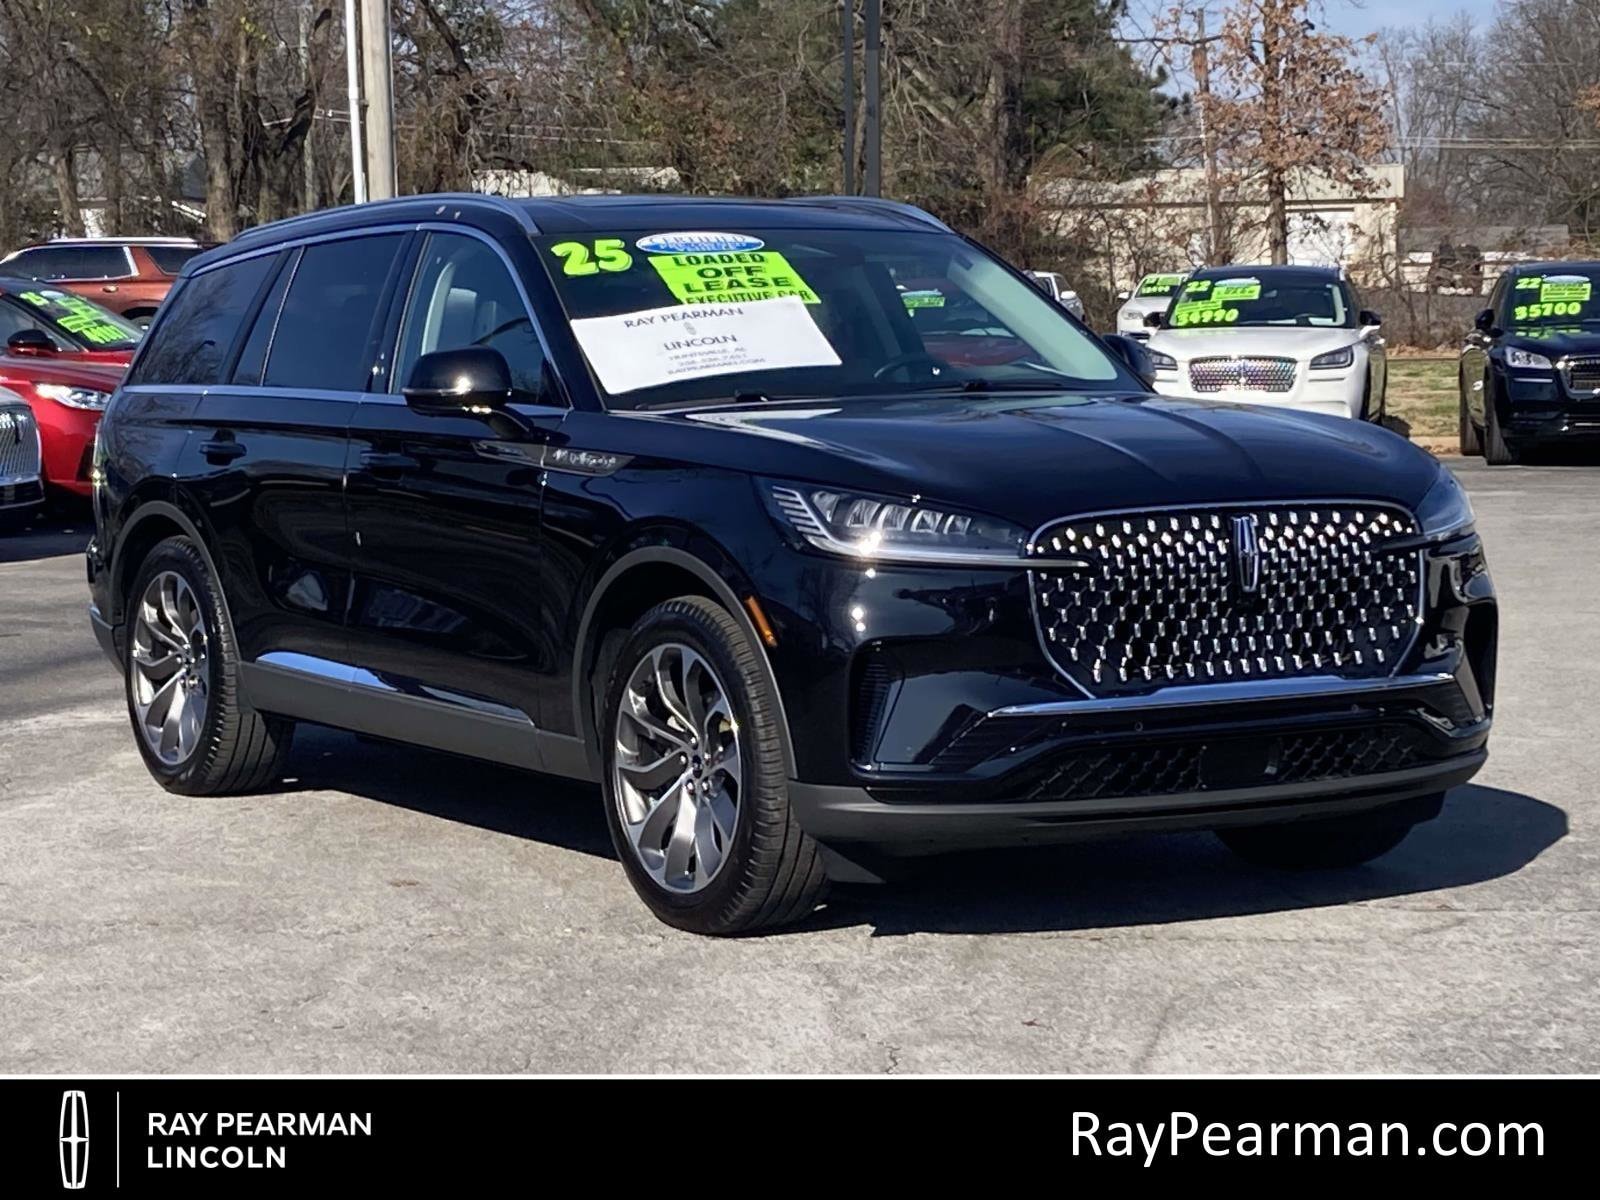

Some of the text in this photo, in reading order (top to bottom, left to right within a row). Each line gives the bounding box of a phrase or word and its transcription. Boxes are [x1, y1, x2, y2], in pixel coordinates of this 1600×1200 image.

[551, 238, 633, 276] 25
[671, 253, 766, 267] LOADED
[696, 265, 767, 279] OFF
[682, 276, 796, 294] LEASE
[1185, 280, 1212, 293] 22
[1515, 277, 1542, 290] 22
[624, 306, 745, 329] RAY PEARMAN
[663, 333, 739, 351] LINCOLN
